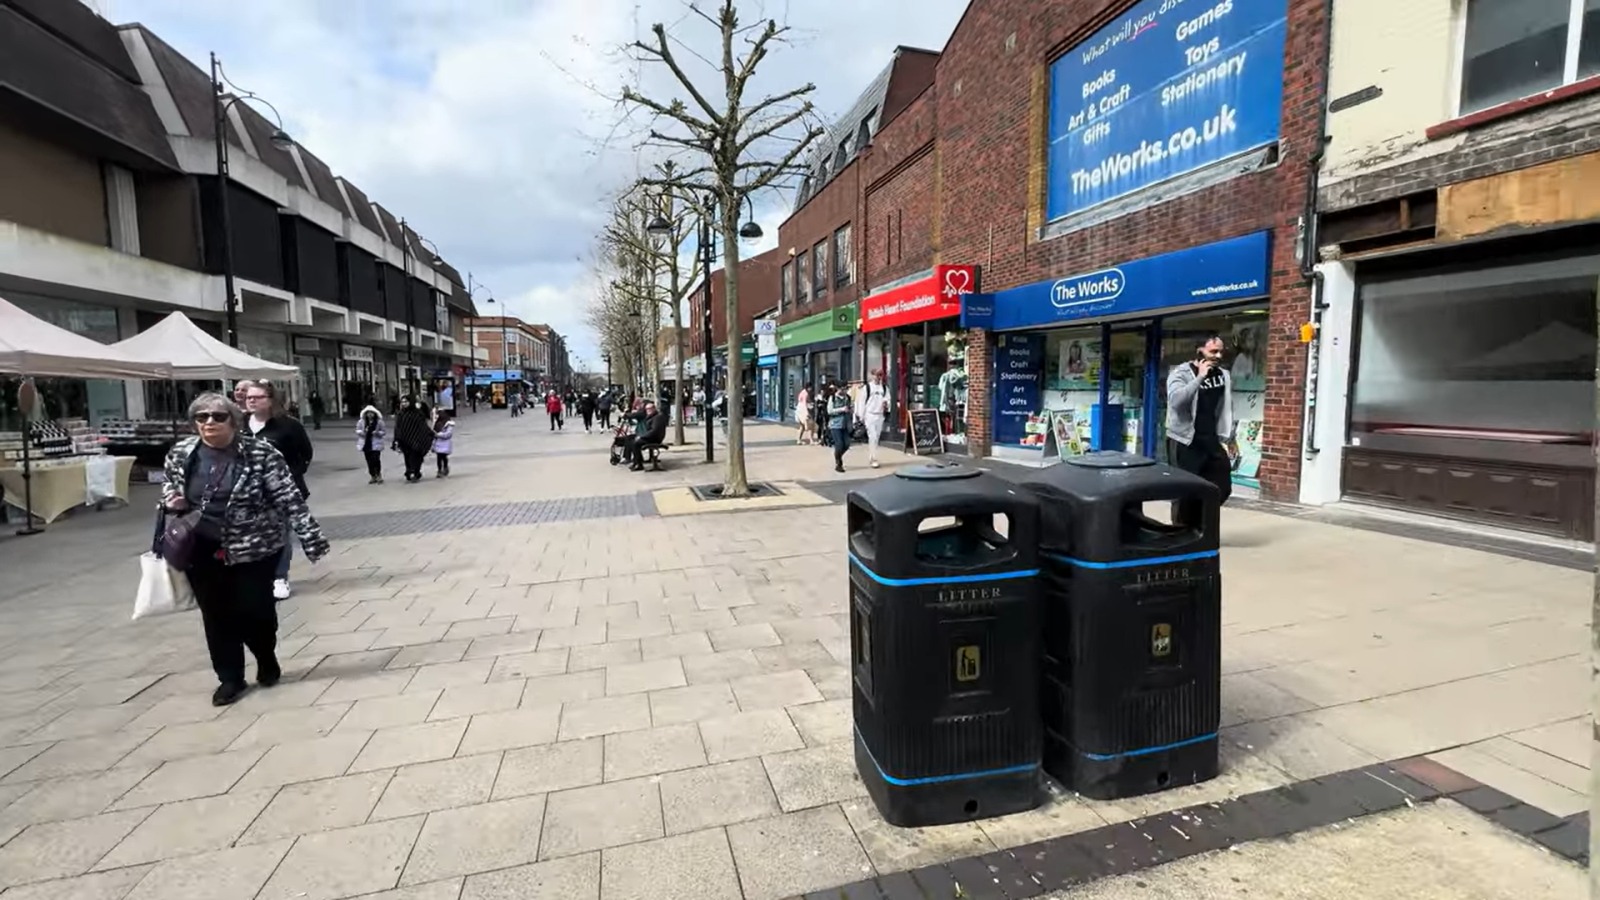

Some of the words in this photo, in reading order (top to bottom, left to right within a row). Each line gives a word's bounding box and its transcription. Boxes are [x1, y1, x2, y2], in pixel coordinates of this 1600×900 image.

[1176, 0, 1233, 41] Games
[1082, 37, 1111, 65] What
[1112, 18, 1132, 46] will
[1131, 11, 1156, 39] you
[1184, 36, 1219, 66] Toys
[1082, 69, 1116, 99] Books
[1161, 51, 1247, 106] Stationery
[1068, 110, 1085, 131] Art
[1087, 103, 1097, 120] &
[1100, 84, 1131, 113] Craft
[1083, 121, 1111, 145] Gifts
[1071, 104, 1236, 194] TheWorks.co.uk
[1055, 285, 1076, 301] The
[1078, 275, 1118, 297] Works
[1191, 280, 1258, 296] www.TheWorks.co.uk
[900, 294, 936, 312] Foundation
[1000, 371, 1038, 381] Stationery
[1010, 360, 1029, 369] Craft
[1013, 385, 1025, 393] Art
[1009, 398, 1027, 406] Gifts
[939, 587, 1001, 602] LITTER
